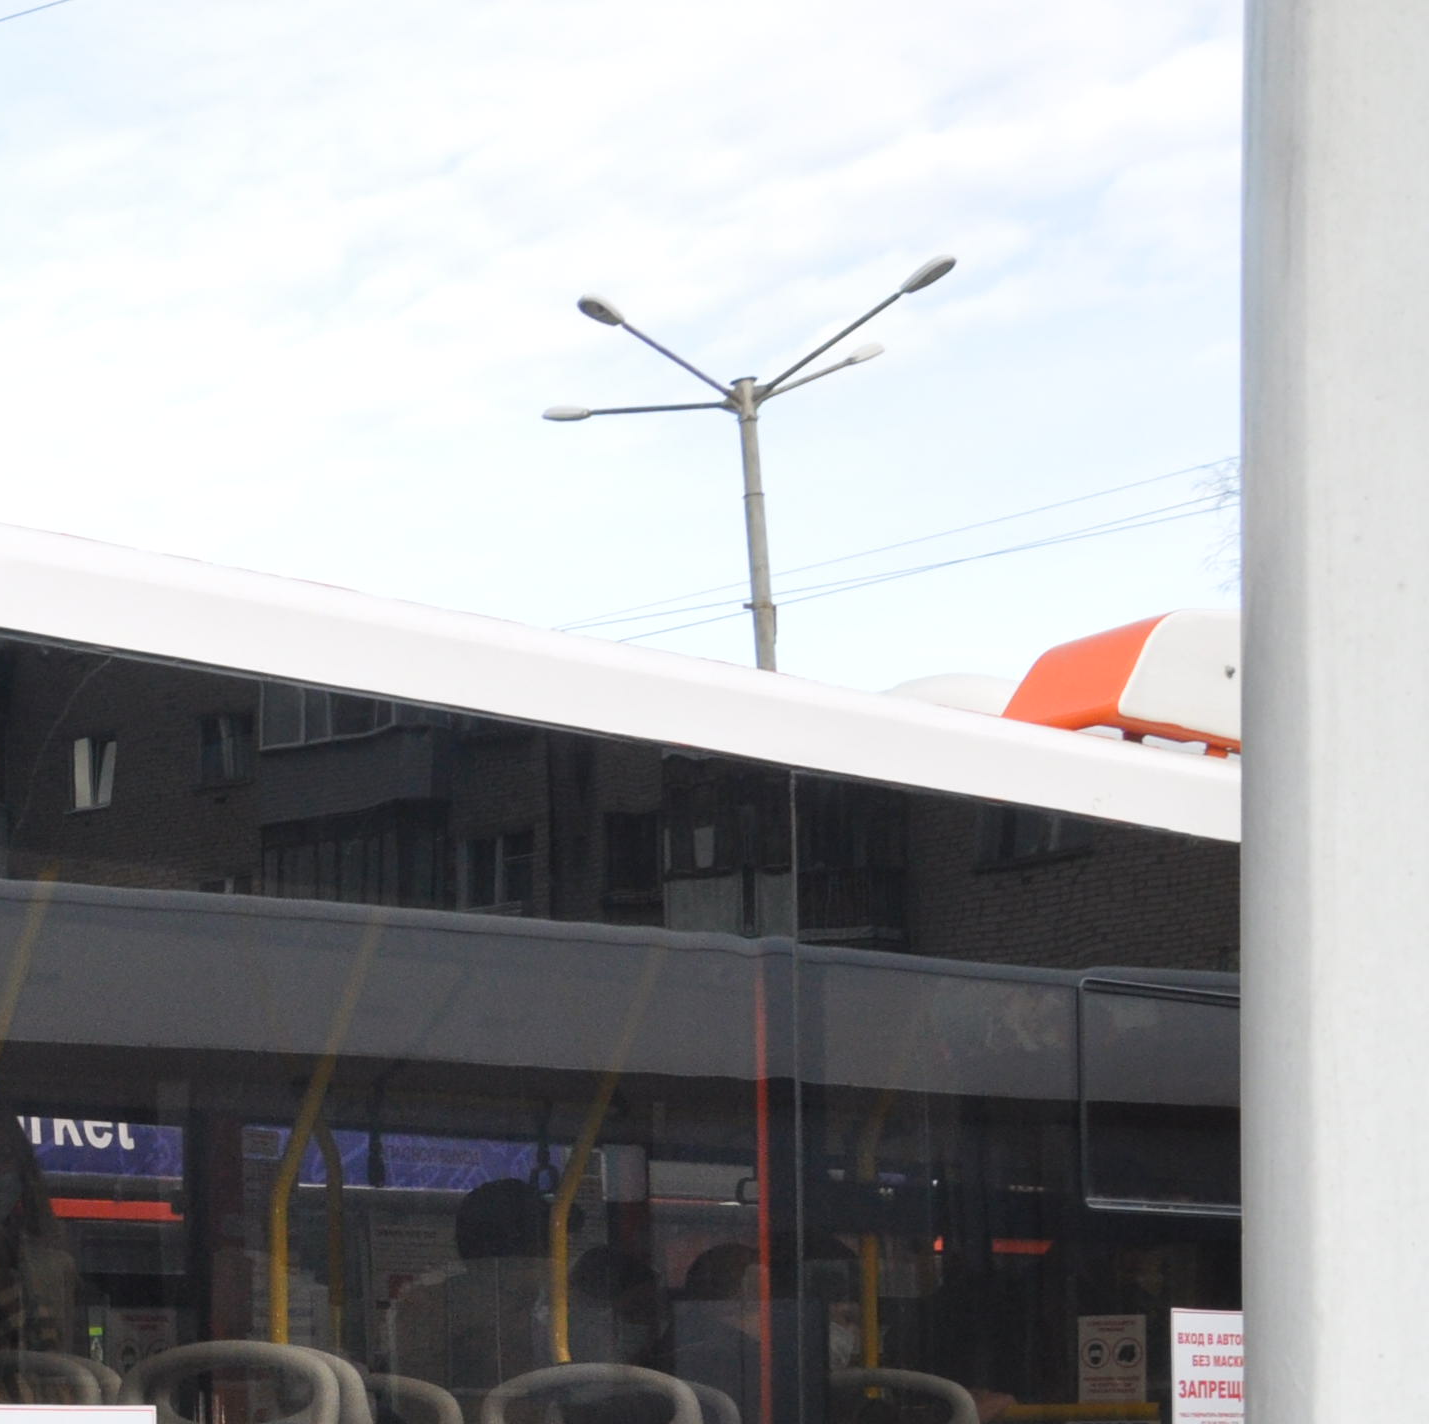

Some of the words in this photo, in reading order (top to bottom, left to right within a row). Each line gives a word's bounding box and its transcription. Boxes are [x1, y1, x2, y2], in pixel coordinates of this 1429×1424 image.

[1177, 1332, 1206, 1347] ВХОД
[1216, 1333, 1245, 1345] АВТО
[1192, 1355, 1211, 1367] БЕЗ
[1178, 1379, 1245, 1402] ЗАПРЕЩ
